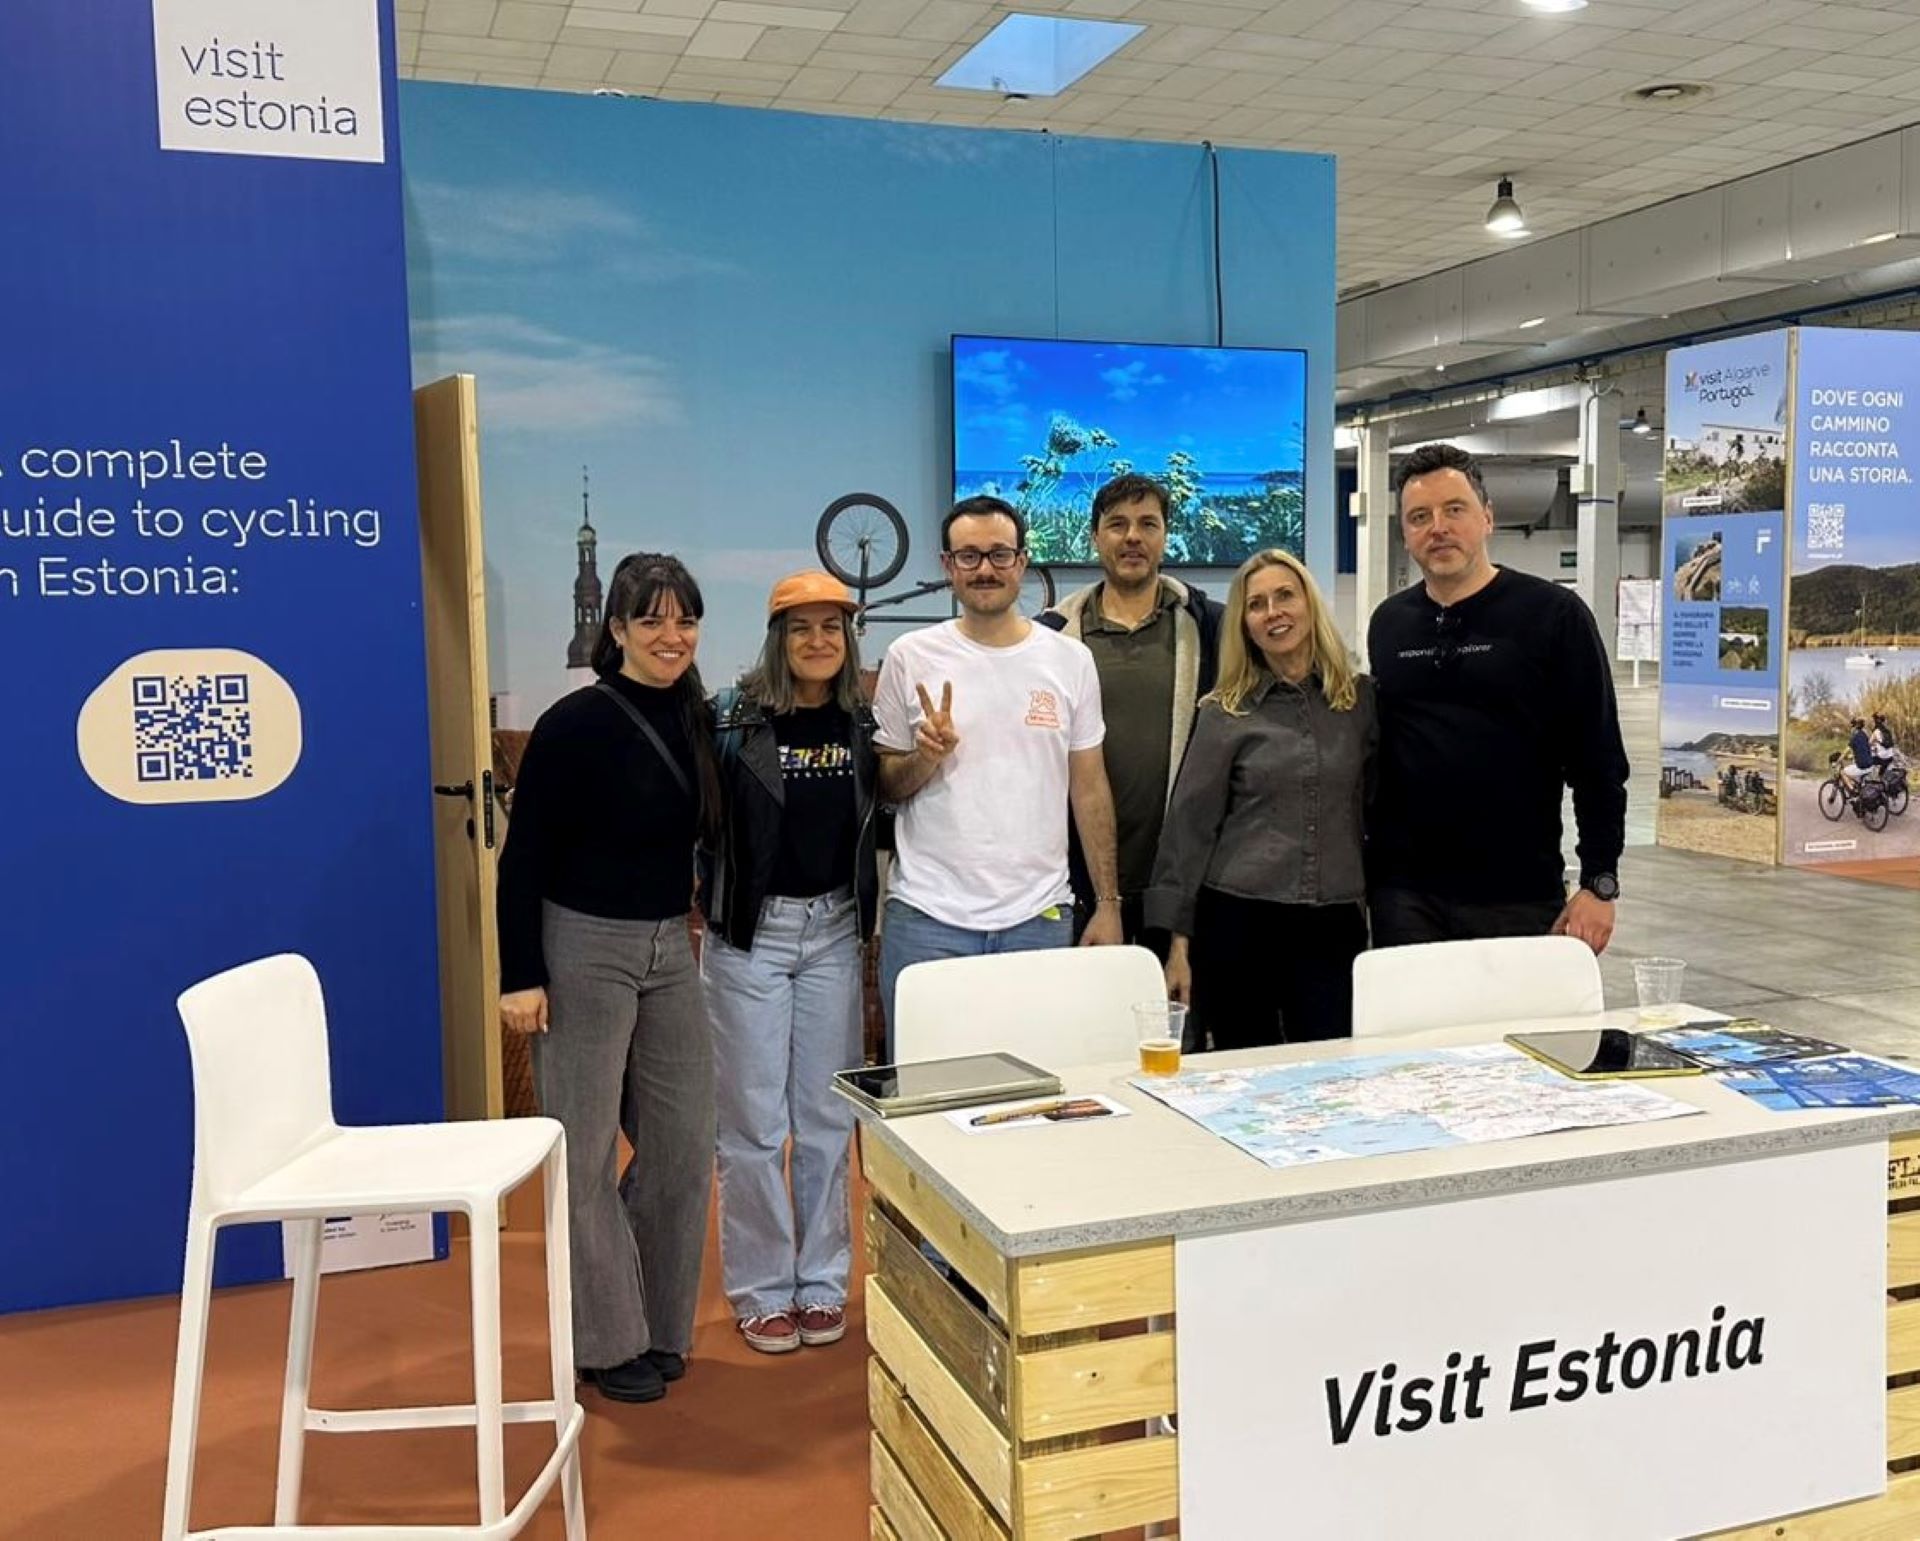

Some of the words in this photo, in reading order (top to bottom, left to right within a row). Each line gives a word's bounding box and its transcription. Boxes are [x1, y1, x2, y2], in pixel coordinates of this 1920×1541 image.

[181, 37, 284, 81] visit
[185, 91, 357, 136] estonia
[1811, 389, 1858, 407] DOVE
[1862, 391, 1904, 408] OGNI
[1811, 415, 1890, 433] CAMMINO
[20, 439, 267, 489] complete
[1809, 441, 1899, 459] RACCONTA
[1809, 466, 1846, 483] UNA
[1849, 466, 1913, 484] STORIA.
[2, 497, 115, 538] uide
[132, 500, 184, 537] to
[201, 499, 381, 547] cycling
[0, 567, 18, 597] n
[39, 556, 240, 597] Estonia:
[1324, 1350, 1490, 1446] Visit
[1508, 1305, 1766, 1412] Estonia
